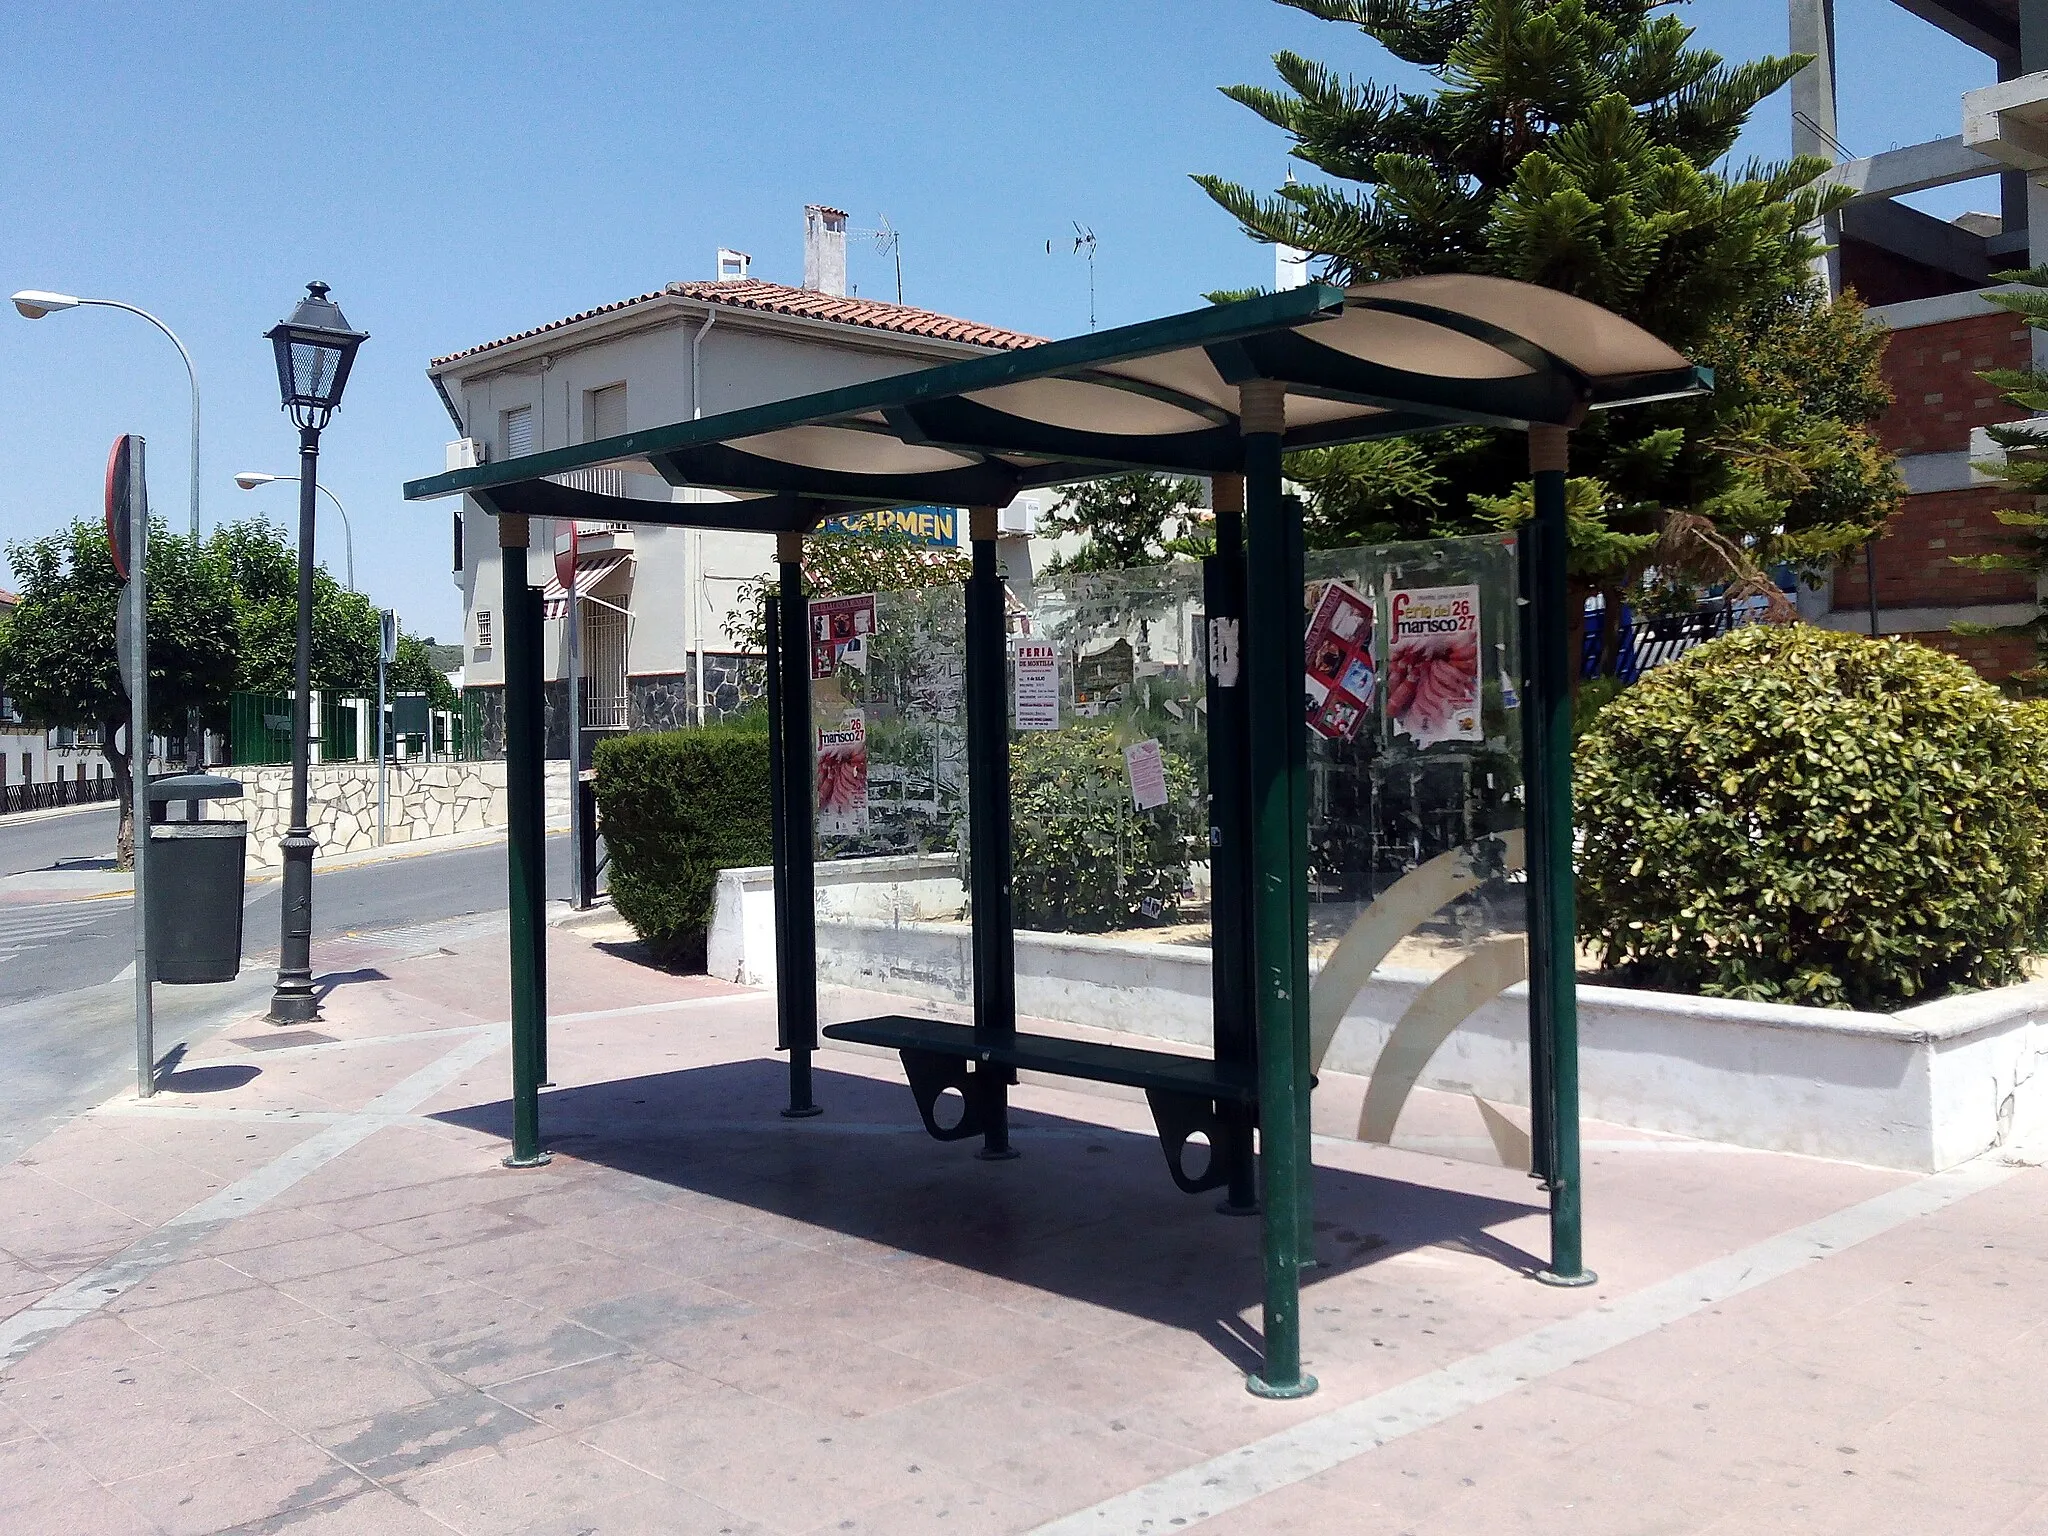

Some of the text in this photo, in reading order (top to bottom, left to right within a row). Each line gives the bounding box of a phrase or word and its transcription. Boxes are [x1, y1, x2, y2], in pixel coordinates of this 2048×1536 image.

[1452, 600, 1470, 616] 26
[1398, 615, 1476, 634] marisco 27
[1019, 648, 1053, 657] FERIA
[850, 718, 861, 731] 26
[821, 730, 865, 743] marisco 27
